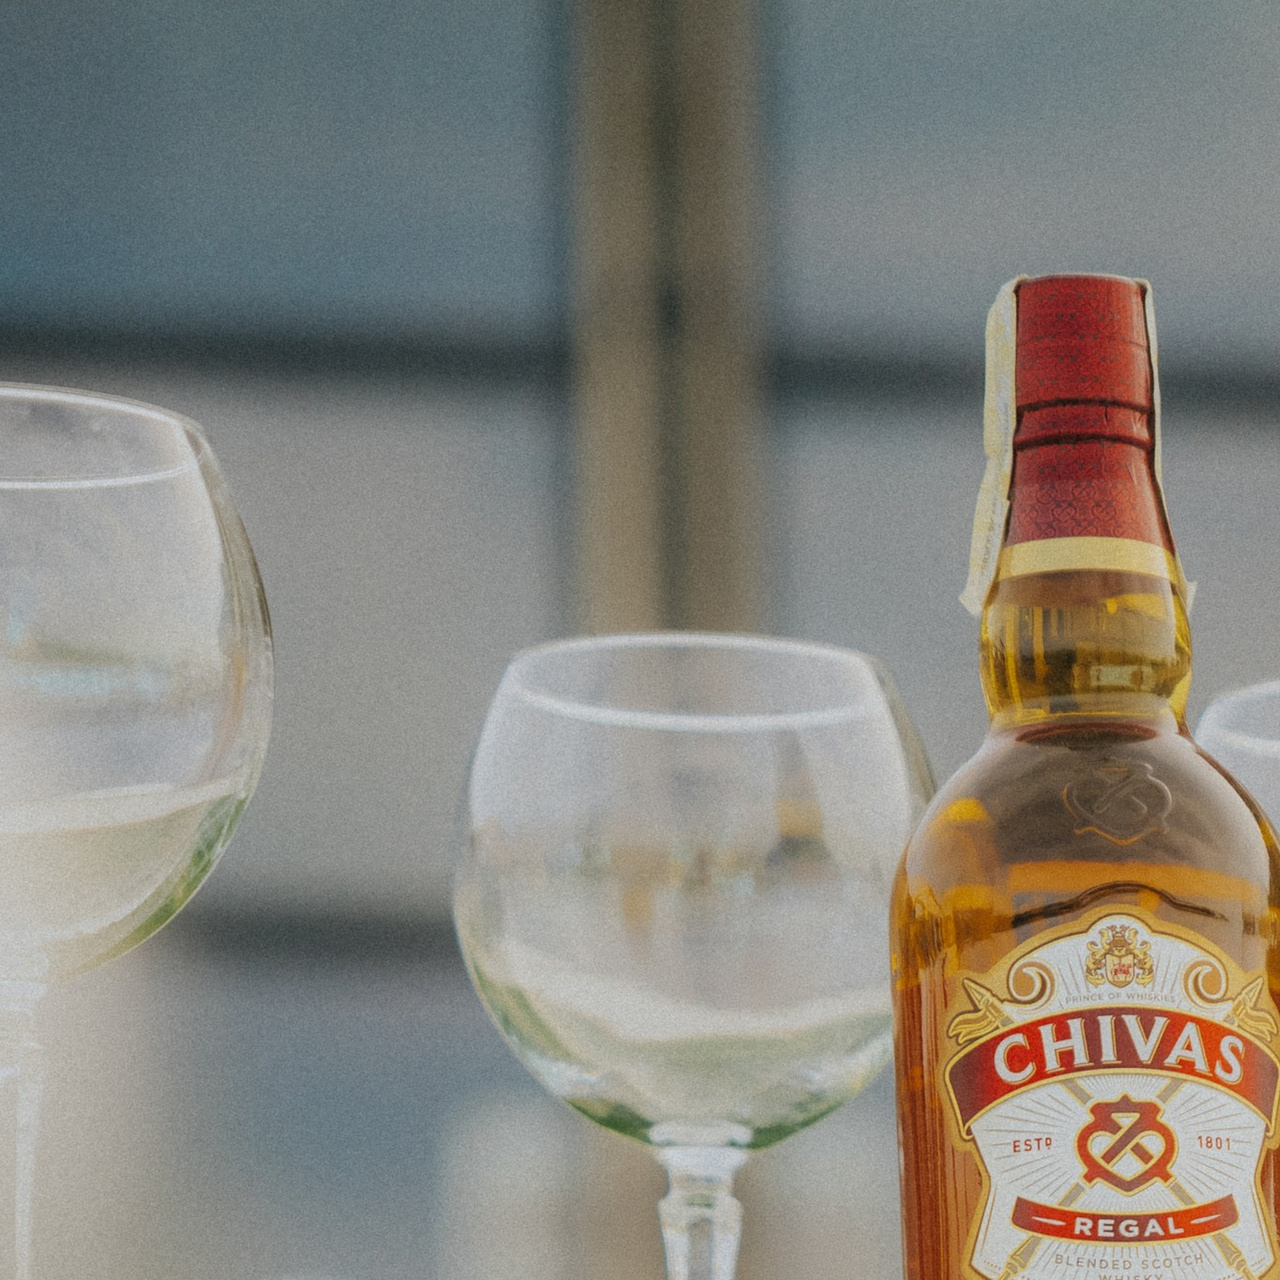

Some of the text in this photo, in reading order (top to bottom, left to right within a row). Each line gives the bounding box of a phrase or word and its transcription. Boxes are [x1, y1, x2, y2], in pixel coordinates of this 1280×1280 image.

[1108, 992, 1122, 1000] OF
[993, 1014, 1246, 1084] CHIVAS
[1198, 1136, 1230, 1151] 1801
[1074, 1217, 1185, 1238] REGAL
[1055, 1254, 1204, 1270] BLENDED SCOTCH
